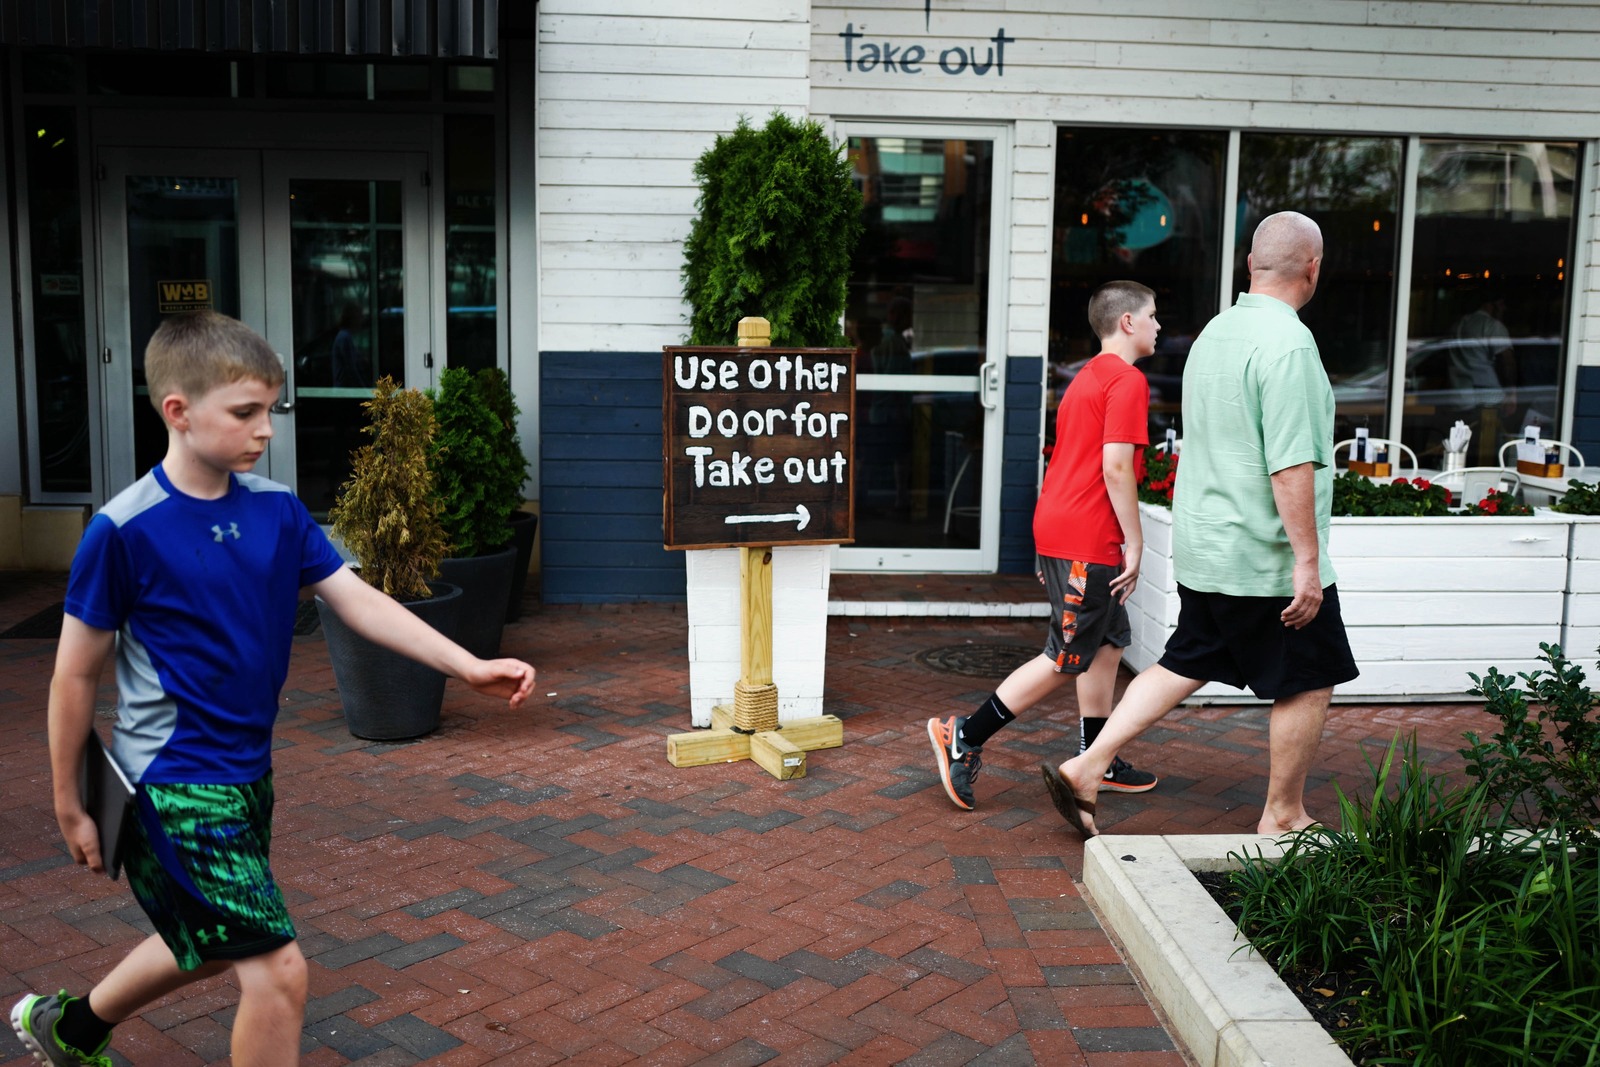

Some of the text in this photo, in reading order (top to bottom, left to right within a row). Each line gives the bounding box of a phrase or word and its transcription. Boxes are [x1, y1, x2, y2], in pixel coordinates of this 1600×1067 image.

[839, 23, 1015, 76] take out
[675, 356, 739, 390] Use
[688, 401, 848, 438] Door for
[685, 446, 847, 488] Take out
